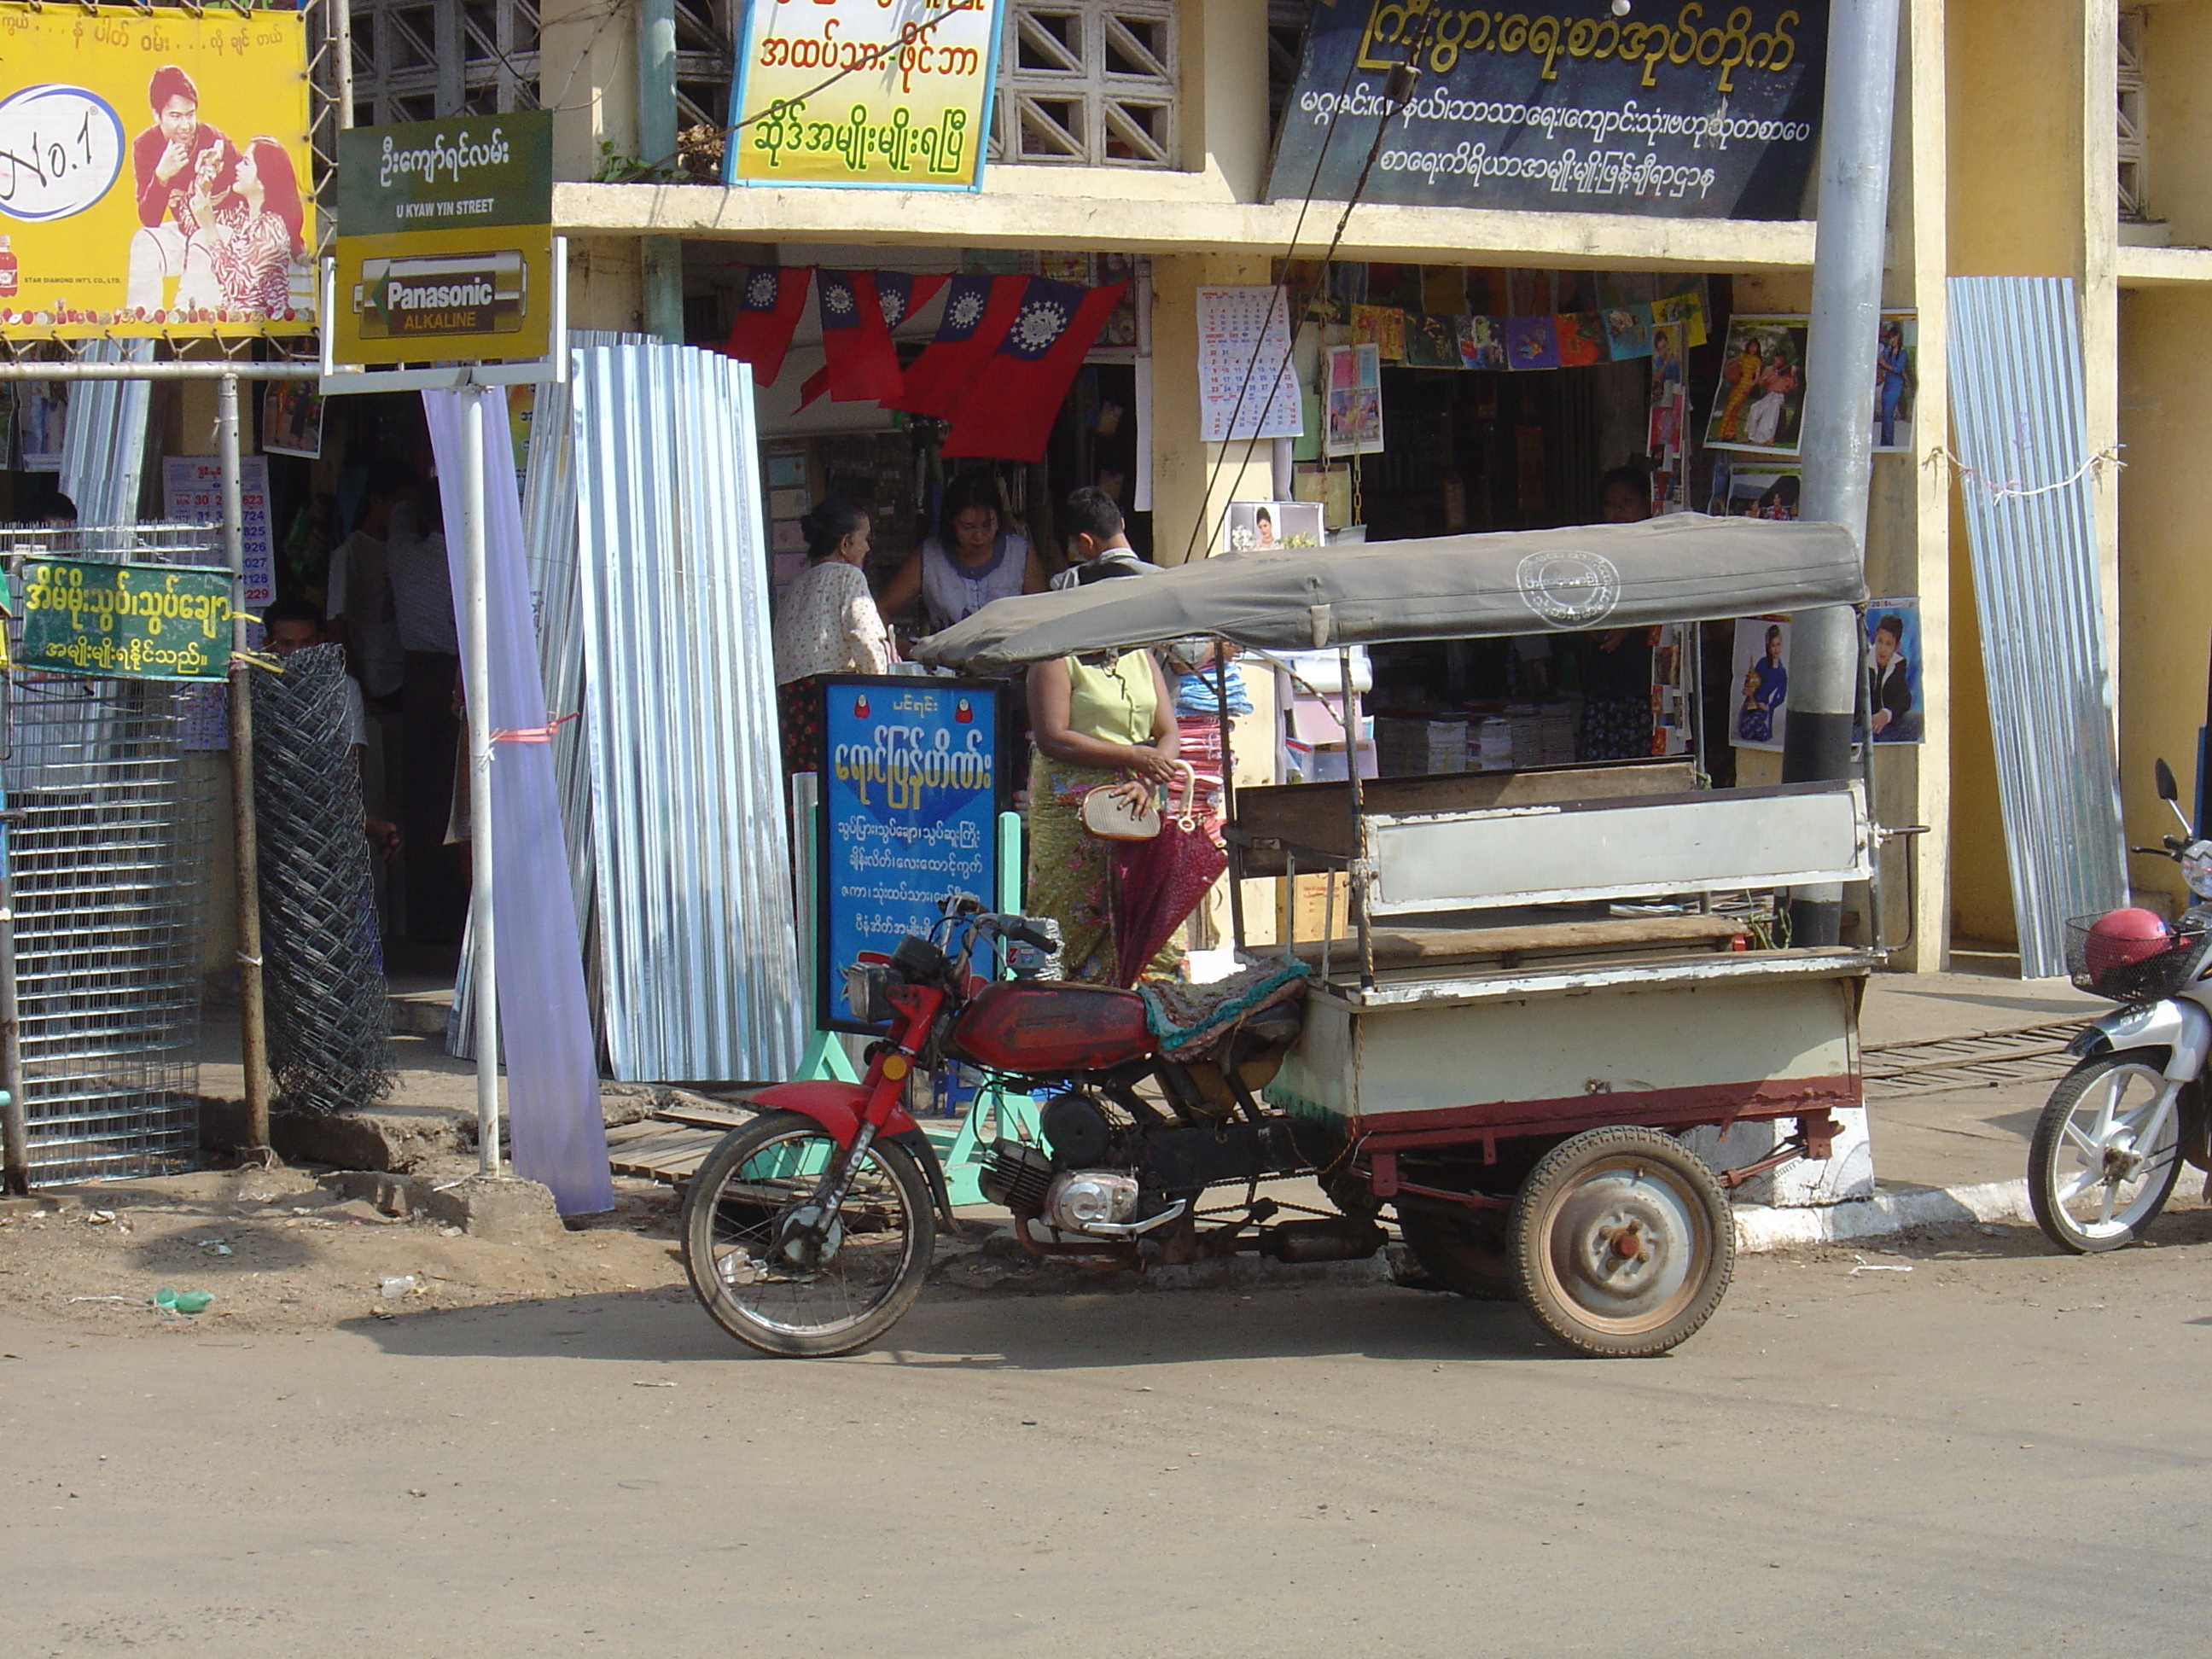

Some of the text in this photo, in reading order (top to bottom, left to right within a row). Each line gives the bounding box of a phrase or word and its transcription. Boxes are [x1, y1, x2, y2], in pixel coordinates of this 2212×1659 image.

[396, 198, 494, 218] U KYAW YIN STREET
[387, 276, 492, 310] Panasonic
[404, 311, 476, 330] ALKALINE
